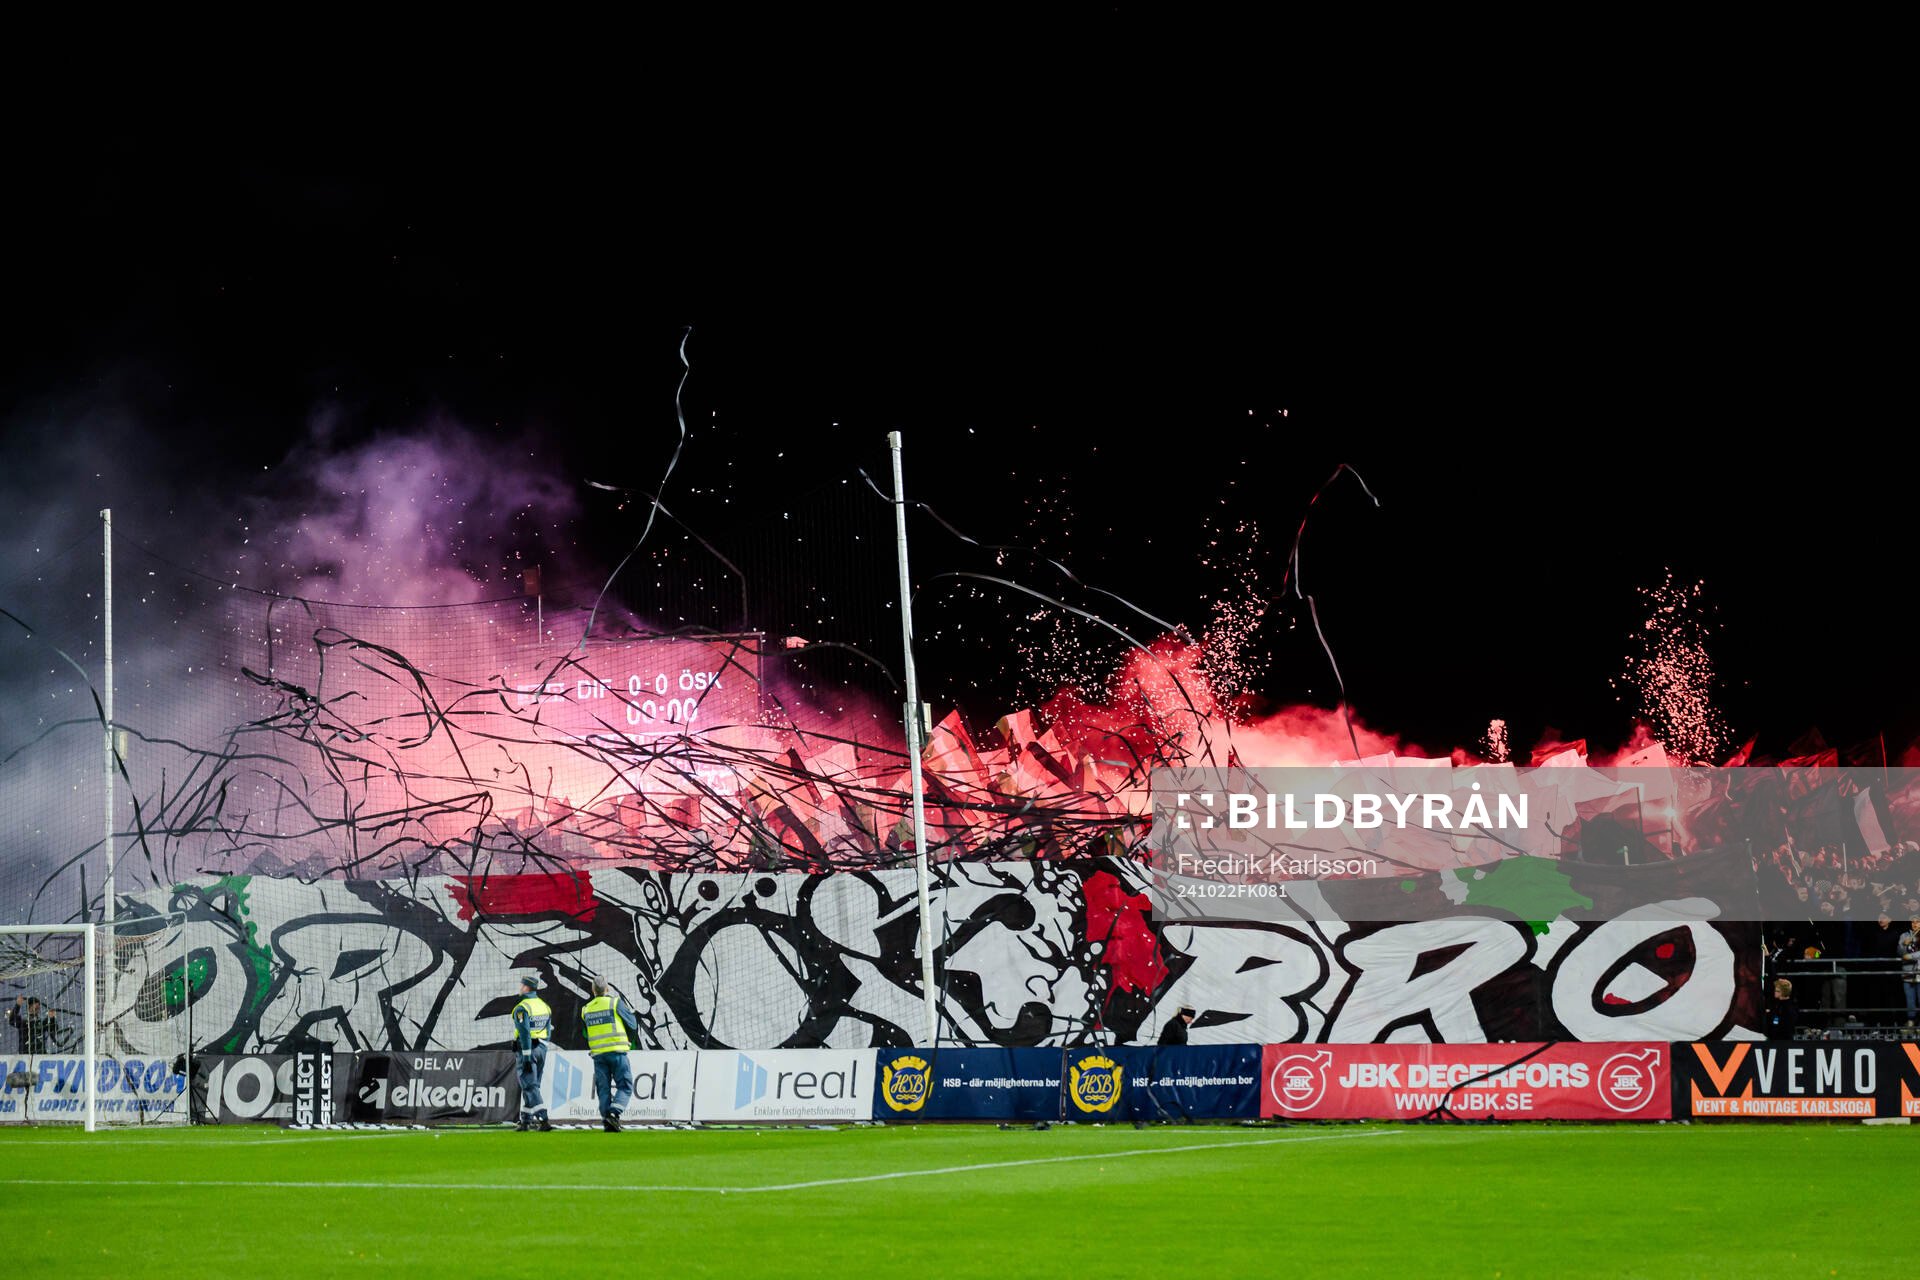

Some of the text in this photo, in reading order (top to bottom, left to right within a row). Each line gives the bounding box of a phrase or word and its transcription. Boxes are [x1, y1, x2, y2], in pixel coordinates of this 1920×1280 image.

[577, 678, 612, 699] DIF
[679, 669, 722, 690] ÖSK
[626, 697, 698, 725] 00:00
[414, 1058, 464, 1071] DEL AV
[1339, 1062, 1590, 1089] JBK DEGERFORS
[1754, 1048, 1876, 1094] VEMO
[297, 1052, 314, 1125] SELECT
[321, 1053, 332, 1125] SELECT
[776, 1060, 858, 1100] real
[943, 1078, 961, 1088] HSB
[969, 1078, 984, 1088] där
[985, 1078, 1044, 1089] möjligheterna
[1045, 1078, 1060, 1087] bor
[1159, 1077, 1174, 1086] där
[1176, 1076, 1237, 1088] möjligheterna
[1238, 1076, 1253, 1085] bor
[1286, 1077, 1311, 1088] JBK
[1614, 1076, 1639, 1088] JBK
[391, 1078, 506, 1113] elkedjan
[1695, 1100, 1872, 1114] VENT & MONTAGE KARLSKOGA
[754, 1106, 781, 1116] Enklare
